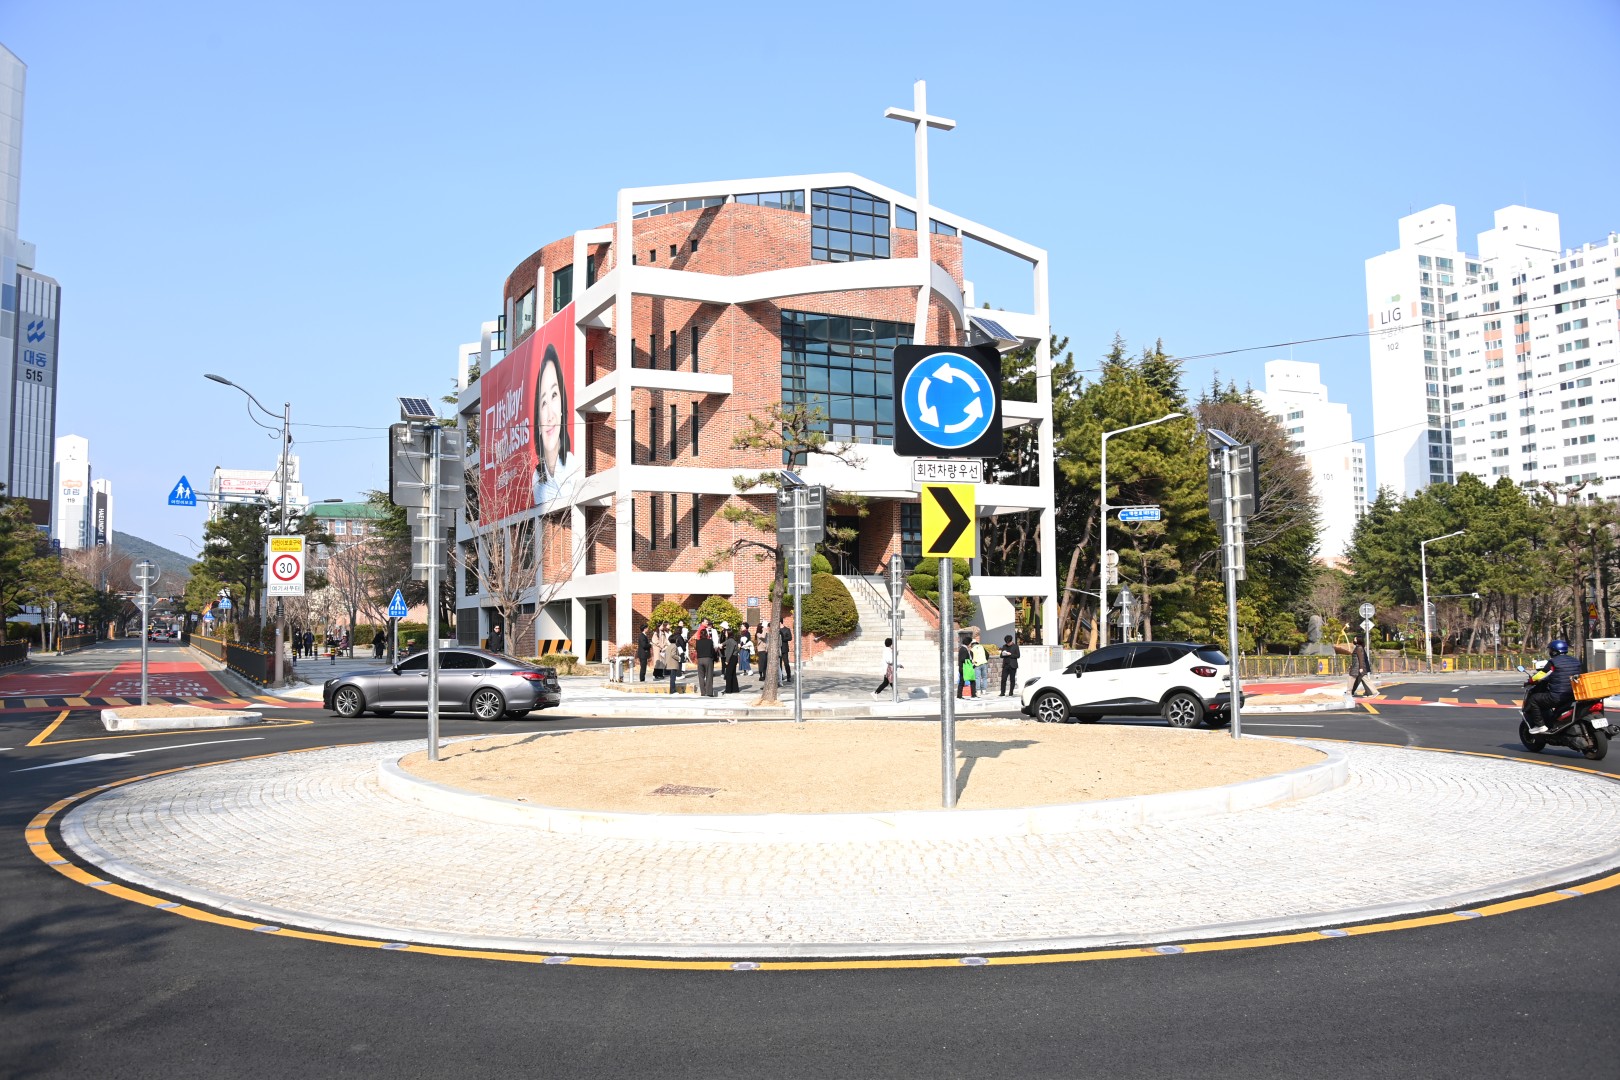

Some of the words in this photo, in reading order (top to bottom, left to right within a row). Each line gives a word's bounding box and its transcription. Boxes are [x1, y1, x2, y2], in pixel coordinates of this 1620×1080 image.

[1380, 307, 1402, 325] LIG
[1387, 341, 1400, 351] 102
[23, 349, 47, 368] 대동
[25, 368, 43, 383] 515
[917, 463, 978, 479] 회전차량우선
[279, 562, 293, 574] 30
